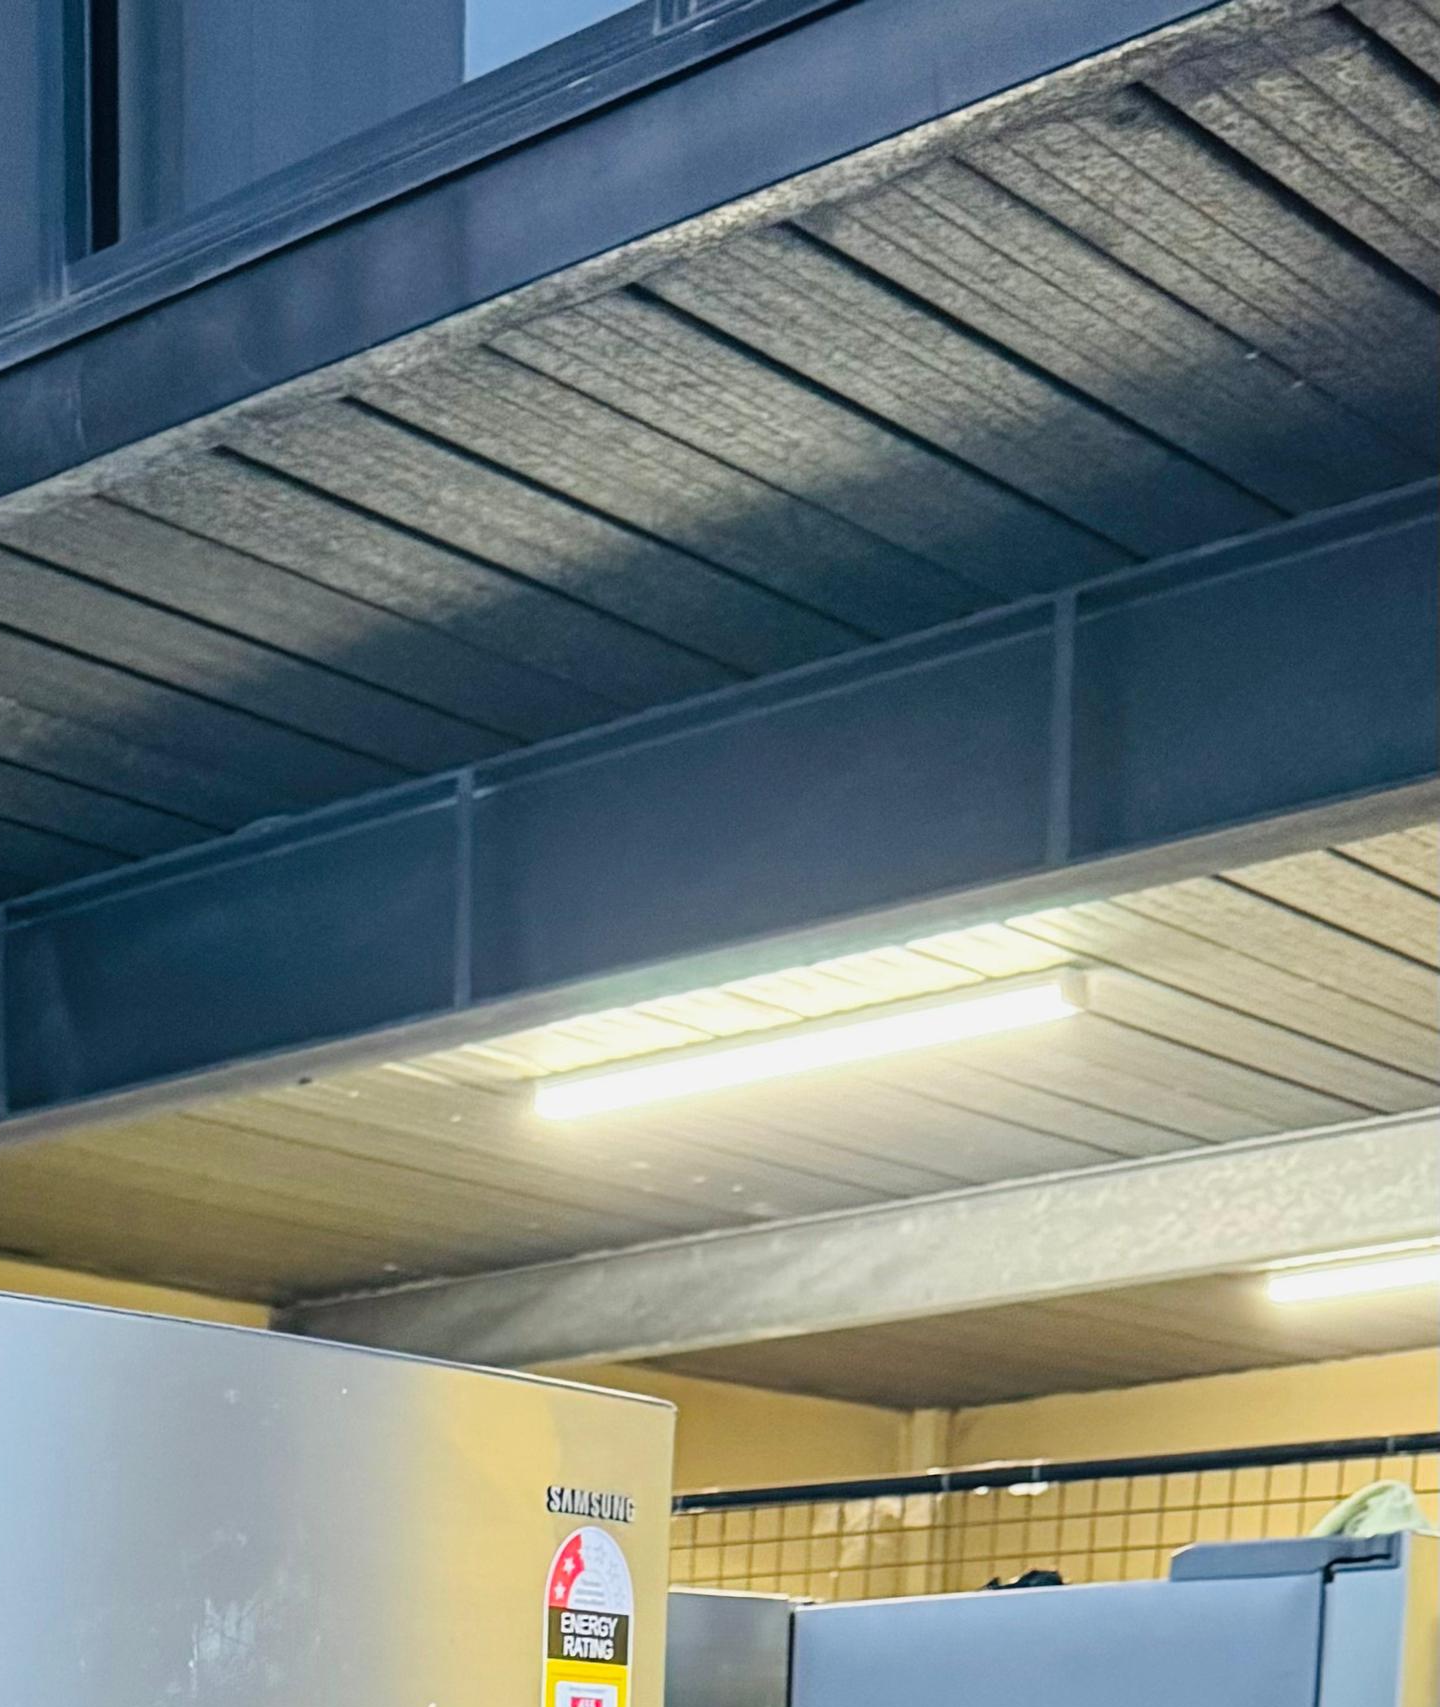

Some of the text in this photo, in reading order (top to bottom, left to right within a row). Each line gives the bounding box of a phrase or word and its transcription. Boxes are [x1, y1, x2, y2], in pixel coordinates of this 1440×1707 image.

[547, 1486, 635, 1523] SAMSUNG
[561, 1612, 618, 1638] ENERGY
[563, 1635, 614, 1660] RATING
